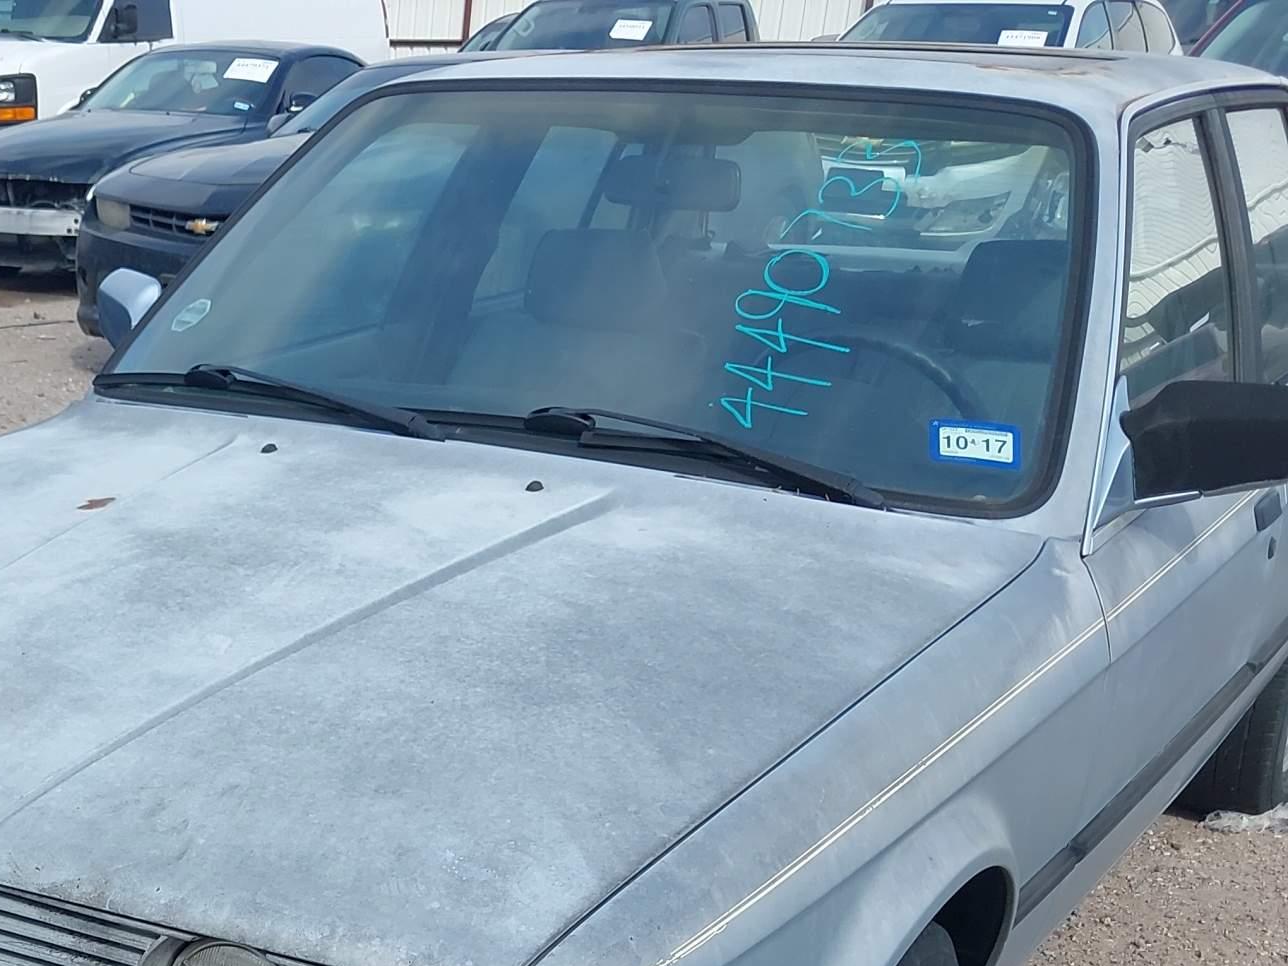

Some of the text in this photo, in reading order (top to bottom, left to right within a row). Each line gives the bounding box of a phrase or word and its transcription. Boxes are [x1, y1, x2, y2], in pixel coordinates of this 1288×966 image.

[720, 140, 922, 430] 44490733
[942, 435, 968, 450] 10
[981, 438, 1008, 454] 17
